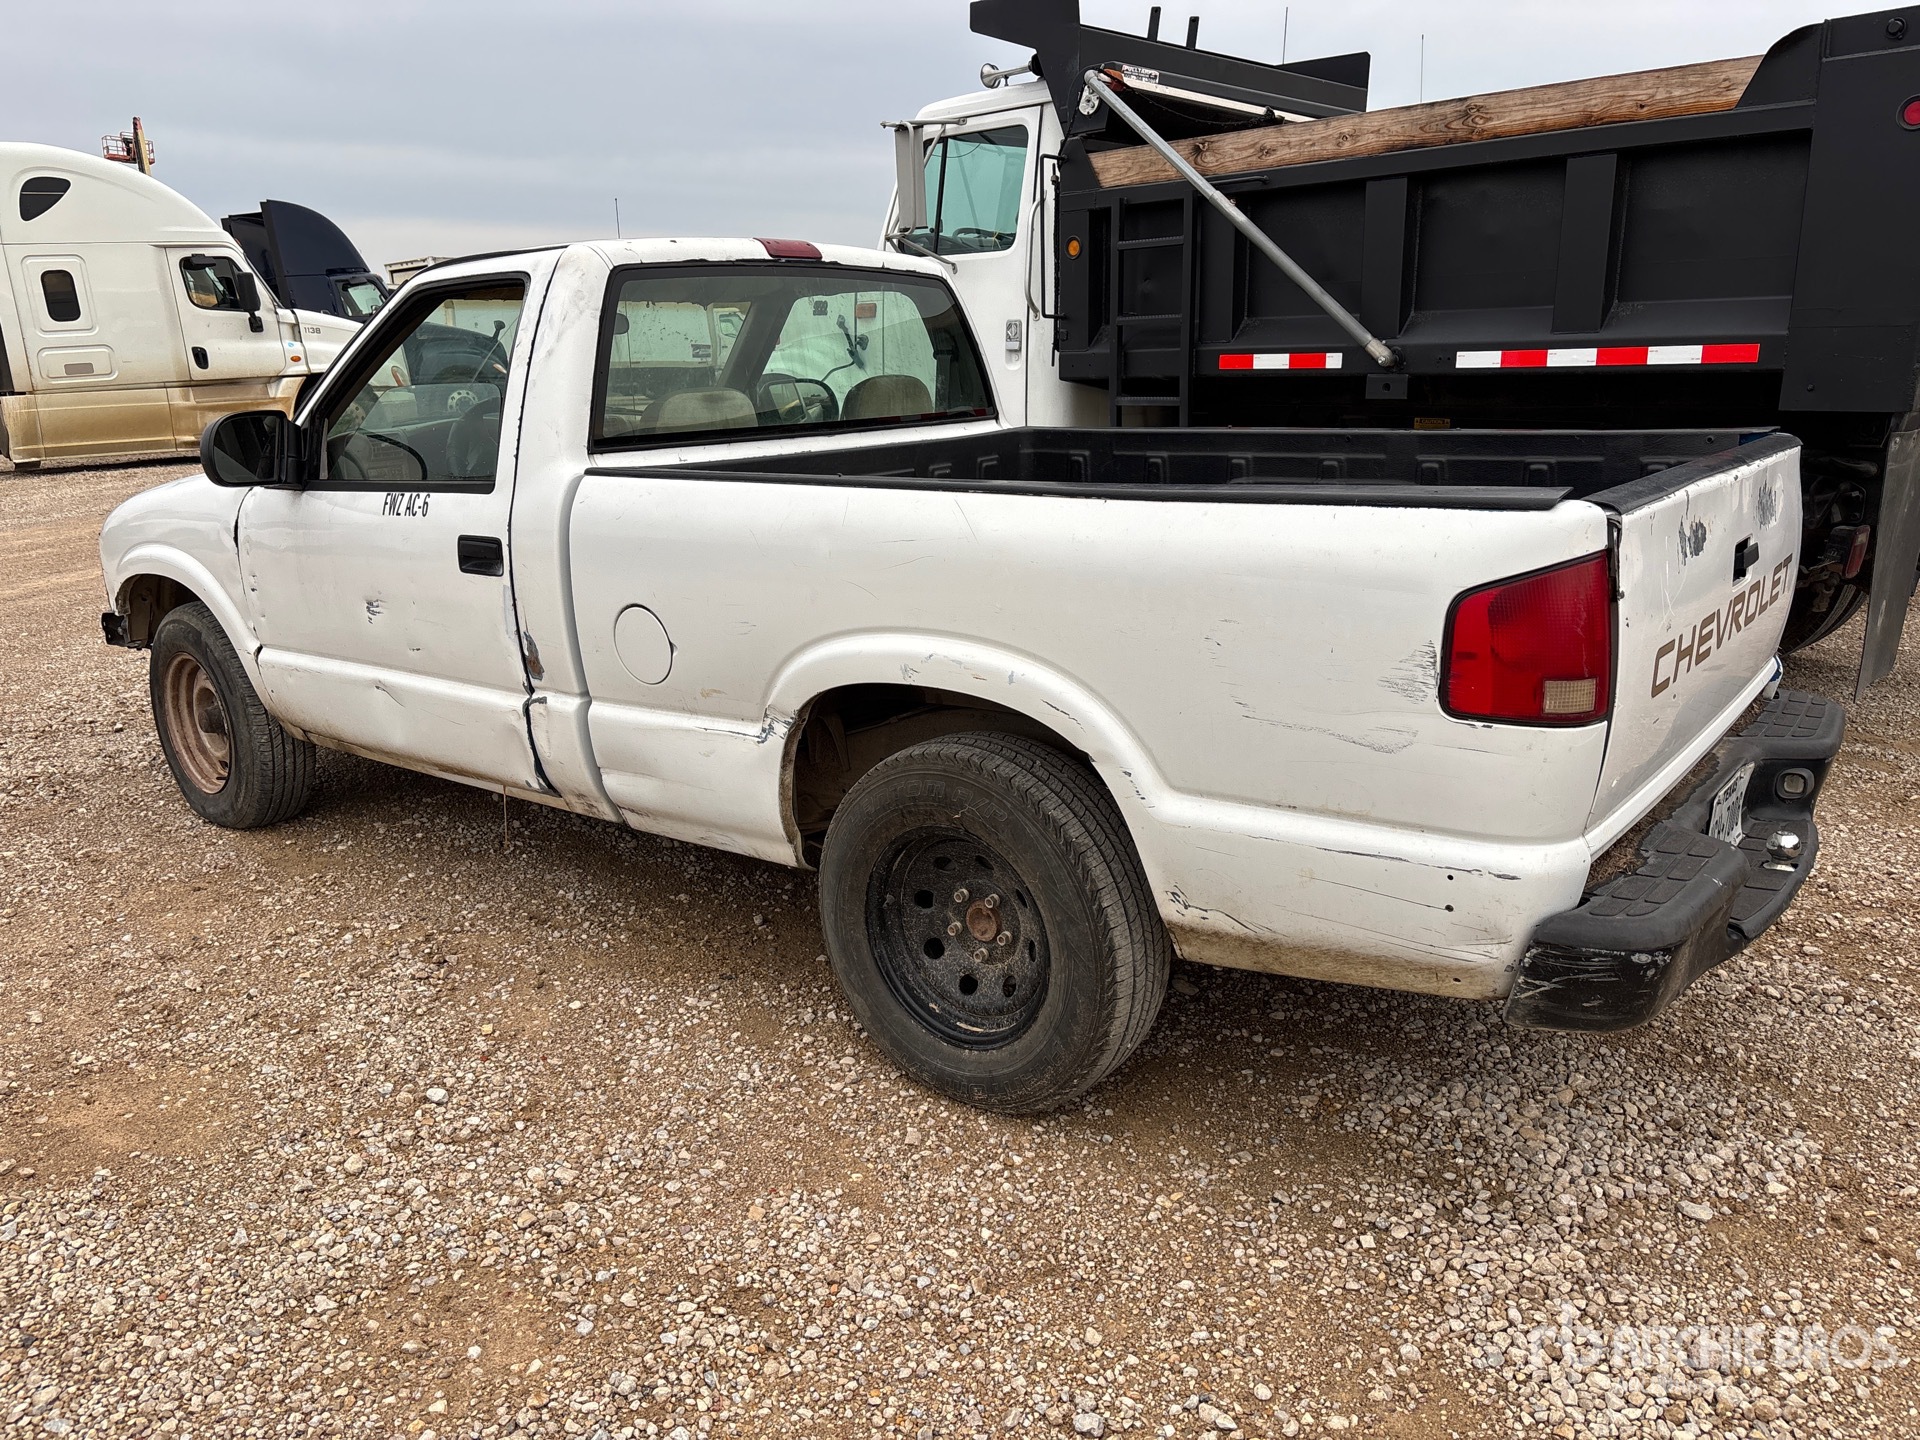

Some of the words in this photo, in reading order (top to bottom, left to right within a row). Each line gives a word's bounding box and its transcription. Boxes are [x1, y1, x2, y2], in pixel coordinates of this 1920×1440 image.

[303, 326, 322, 335] 1138
[382, 492, 405, 516] FWZ
[404, 493, 431, 517] AC-6
[1651, 552, 1793, 699] CHEVROLET
